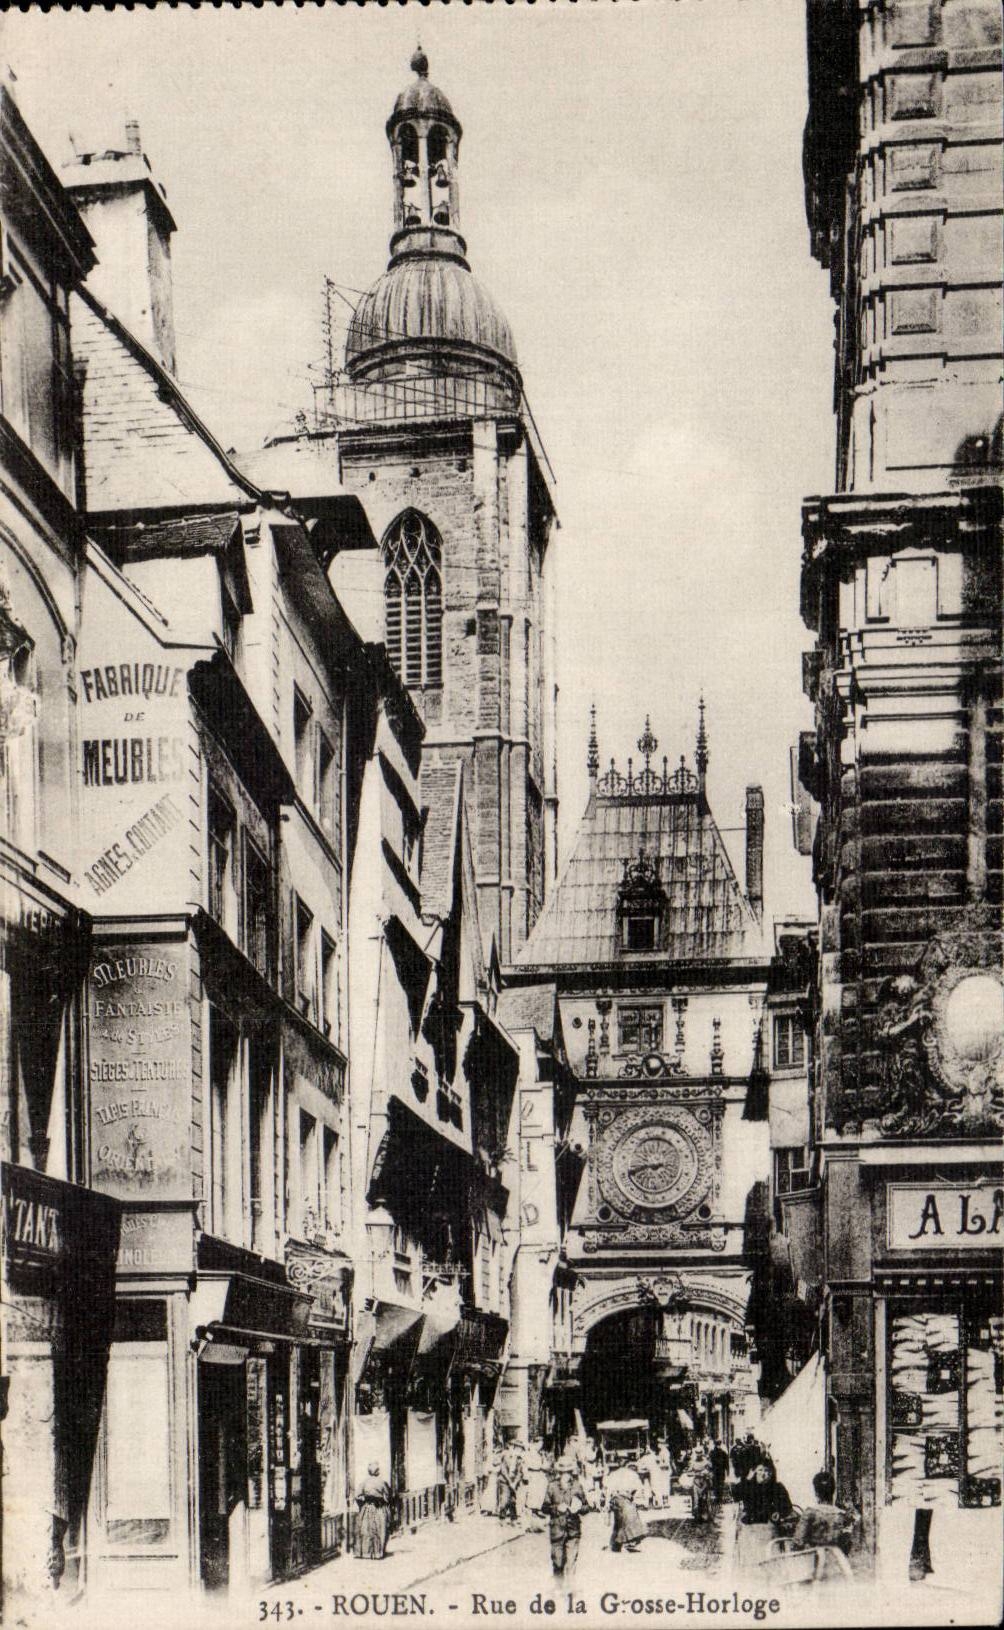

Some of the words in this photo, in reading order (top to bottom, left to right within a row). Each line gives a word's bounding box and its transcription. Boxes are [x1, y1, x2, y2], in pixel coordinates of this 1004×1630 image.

[80, 663, 184, 703] FABRIQUE
[124, 711, 145, 723] DE
[83, 736, 184, 787] MEUBLES
[94, 1000, 182, 1018] FANTAISIE
[908, 1194, 945, 1239] A
